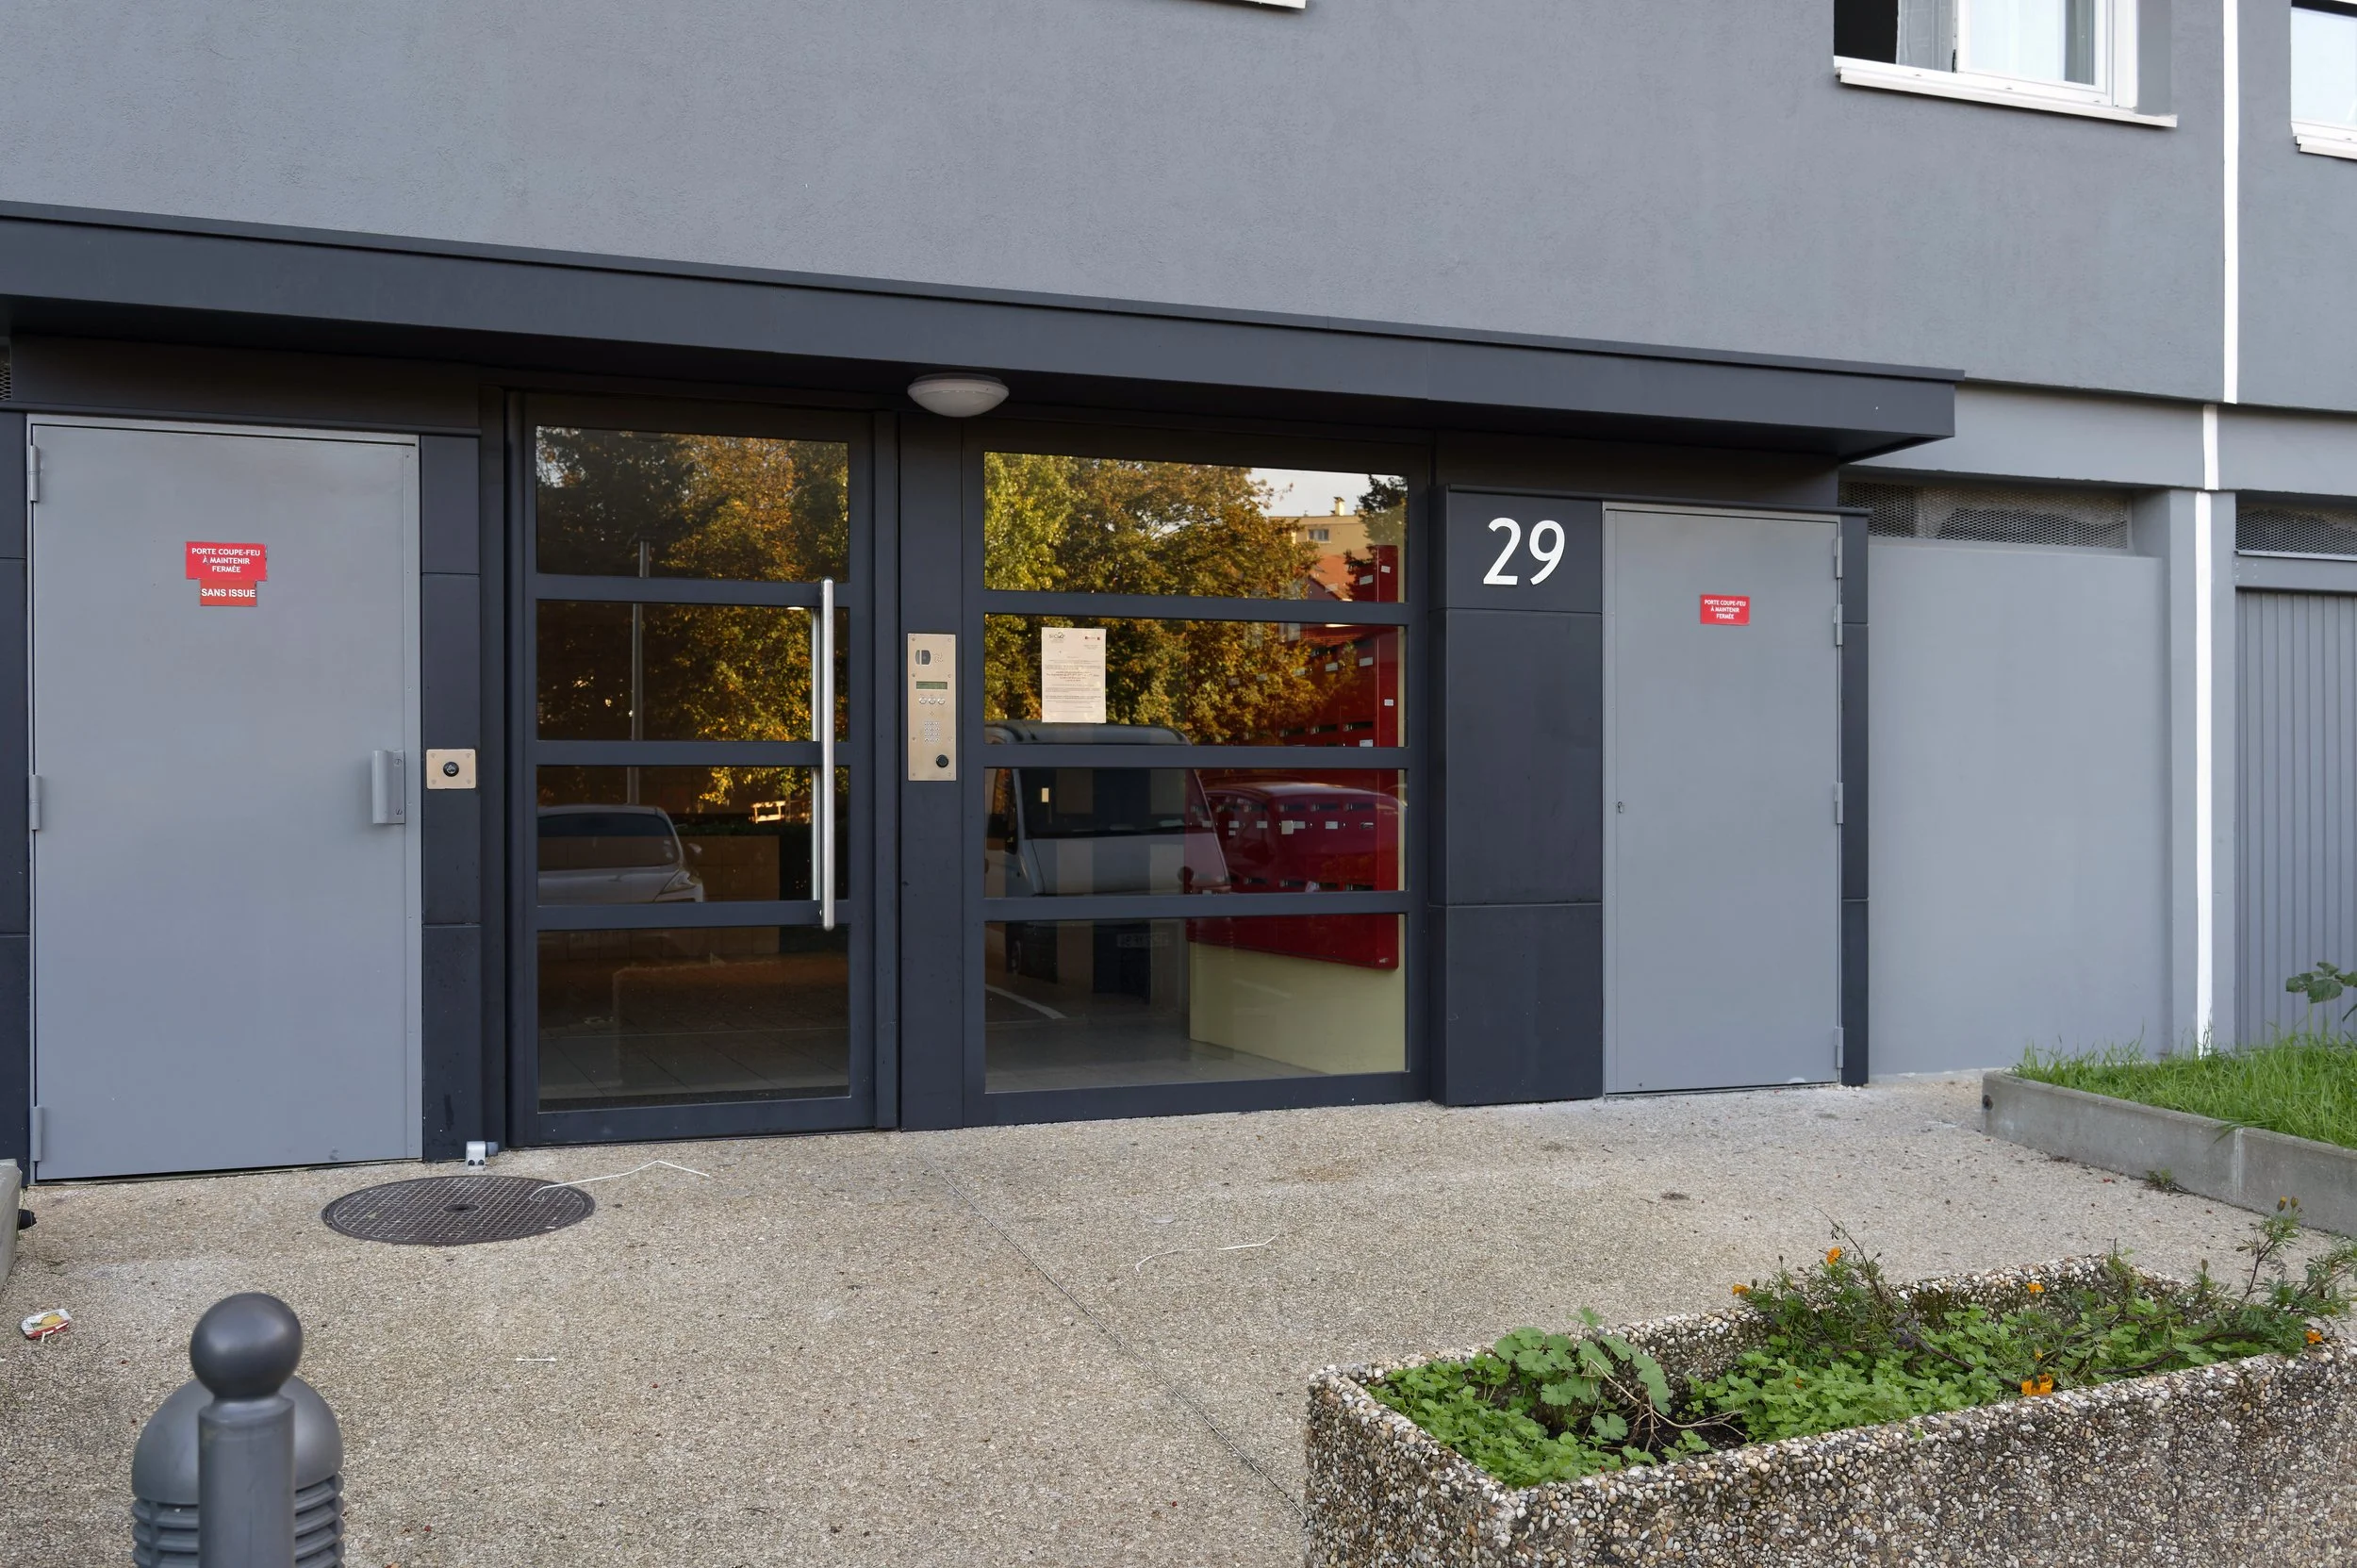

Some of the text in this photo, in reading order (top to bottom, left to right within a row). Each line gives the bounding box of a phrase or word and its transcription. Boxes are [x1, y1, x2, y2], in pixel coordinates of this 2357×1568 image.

[1483, 517, 1565, 586] 29
[203, 555, 207, 564] À
[212, 565, 241, 573] FERMÉE
[201, 588, 256, 598] SANS ISSUE
